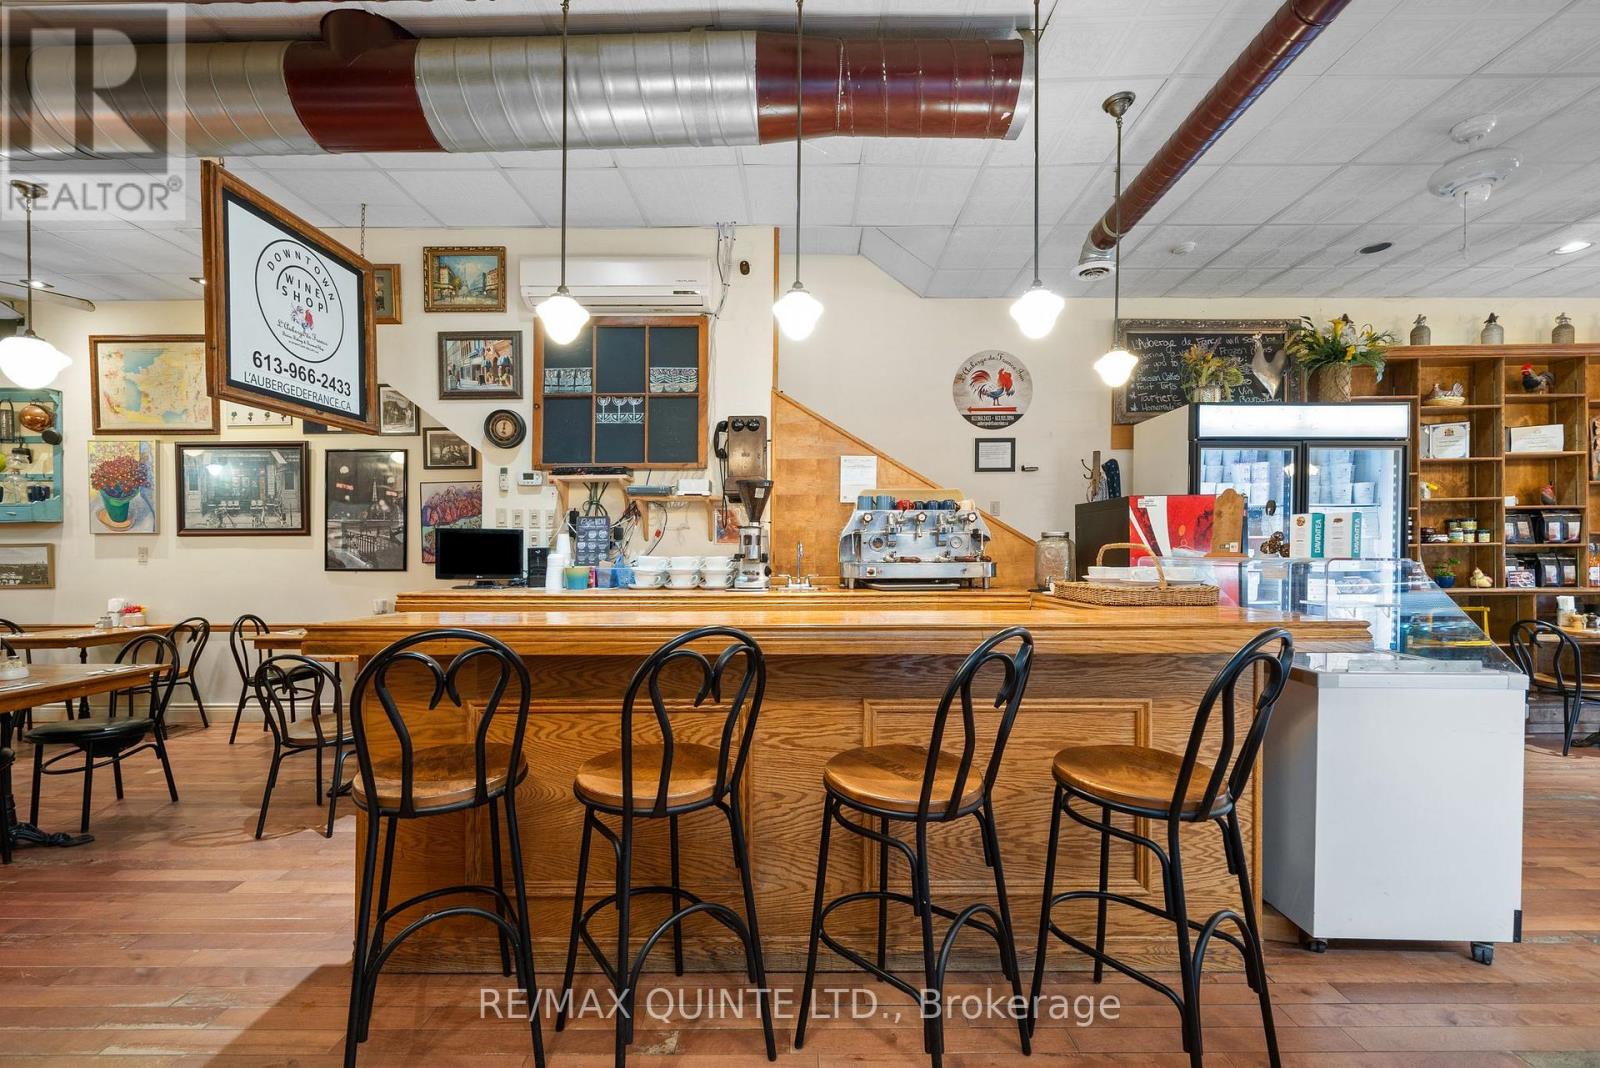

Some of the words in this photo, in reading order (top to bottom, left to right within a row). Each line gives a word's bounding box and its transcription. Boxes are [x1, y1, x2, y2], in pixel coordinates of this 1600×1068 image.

[267, 249, 335, 301] DOWNTOWN
[284, 272, 322, 298] WINE
[281, 285, 324, 313] SHOP
[252, 350, 352, 397] 613-966-2433
